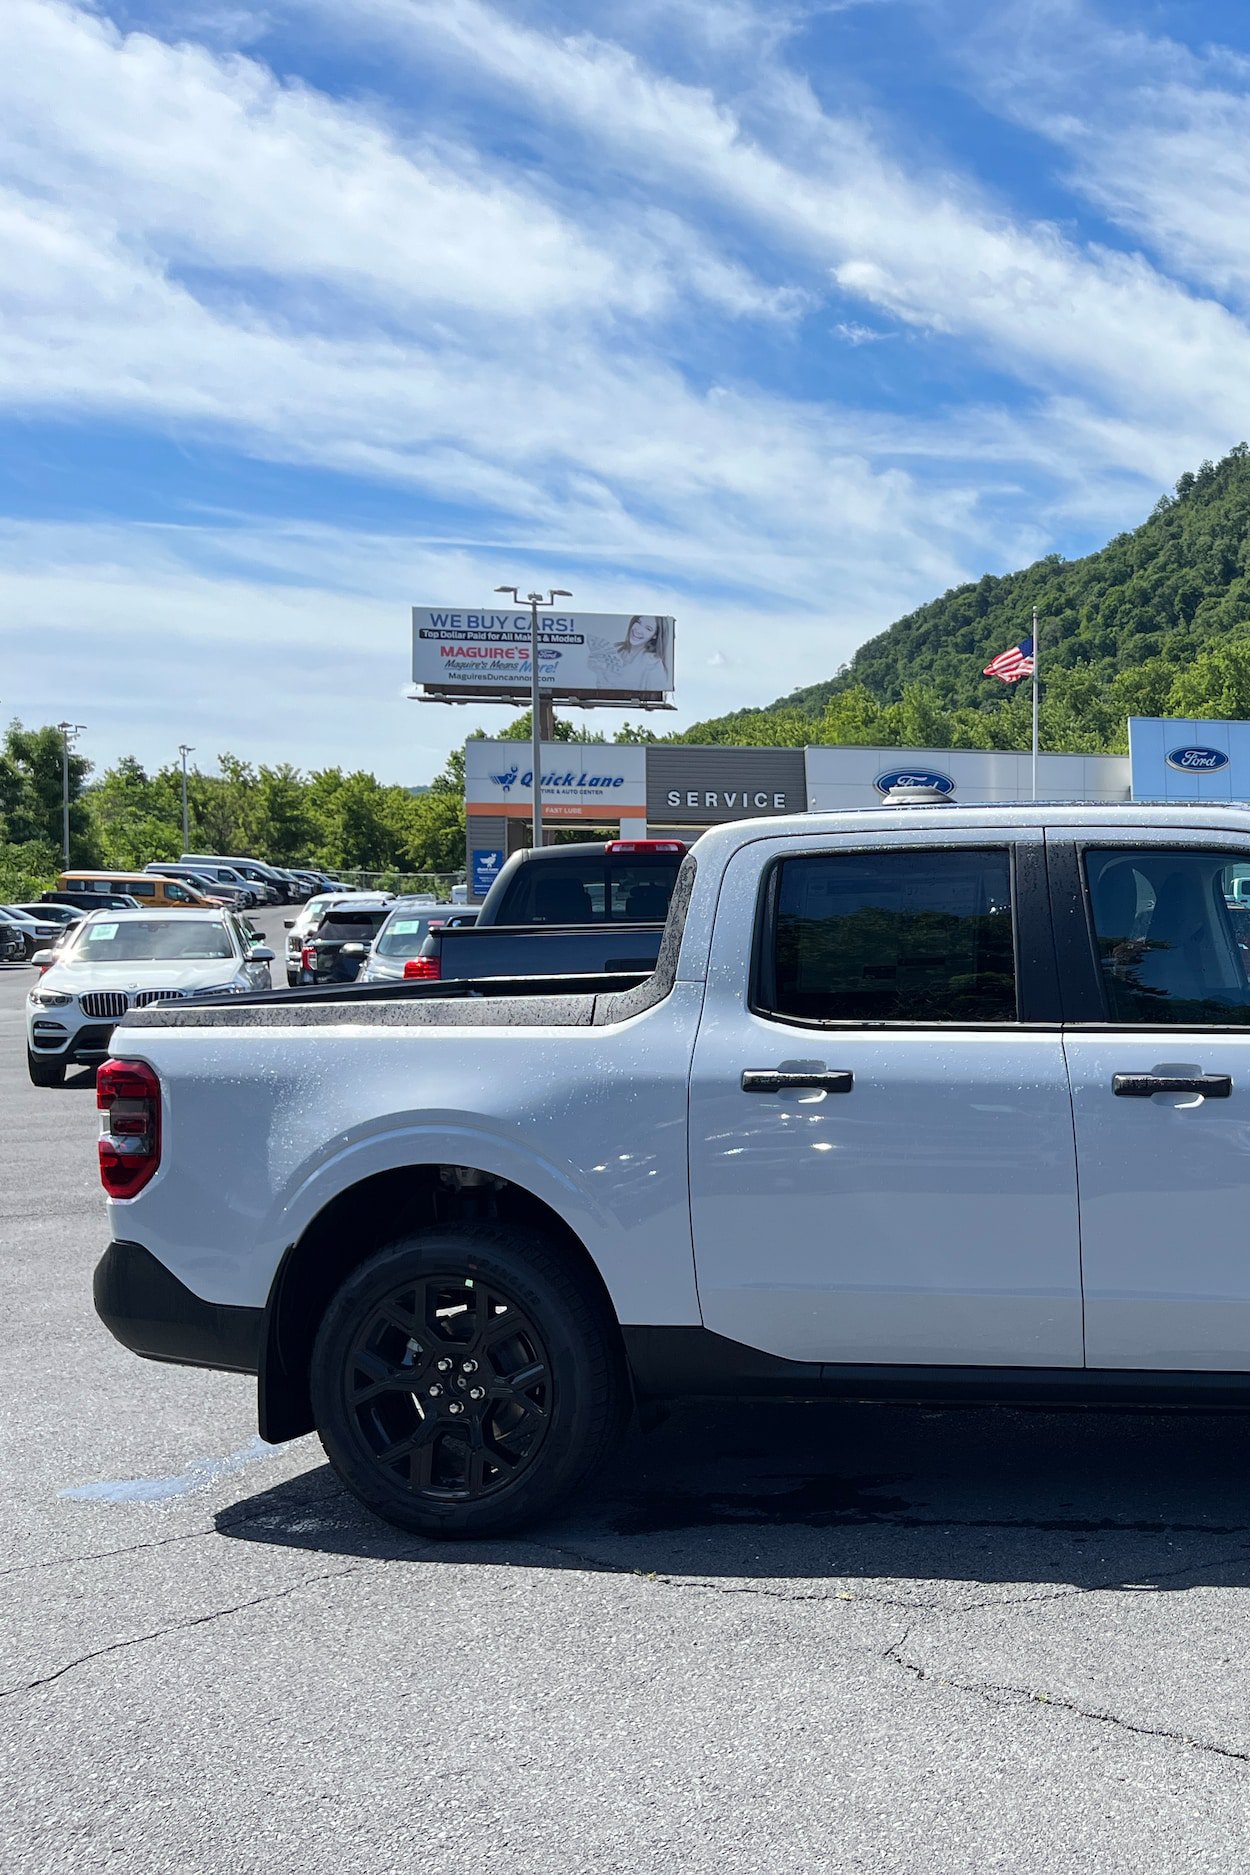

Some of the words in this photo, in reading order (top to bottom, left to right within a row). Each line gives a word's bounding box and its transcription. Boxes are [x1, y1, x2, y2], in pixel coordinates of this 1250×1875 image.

[430, 613, 461, 628] WE
[467, 614, 509, 629] BUY
[423, 629, 439, 639] Top
[440, 630, 466, 640] Dollar
[467, 631, 487, 640] Paid
[487, 632, 500, 640] for
[501, 632, 513, 641] All
[514, 633, 542, 642] Maks
[542, 634, 550, 642] &
[551, 634, 582, 643] Models
[440, 645, 530, 660] MAGUIRE'S
[444, 659, 488, 671] Maguire's
[489, 660, 519, 670] Means
[519, 660, 559, 673] Mre!
[1181, 750, 1217, 767] Ford
[520, 771, 575, 788] Qick
[577, 773, 625, 788] Lane
[667, 790, 786, 809] SERVICE
[545, 806, 562, 814] FAST
[563, 807, 582, 815] LUBE
